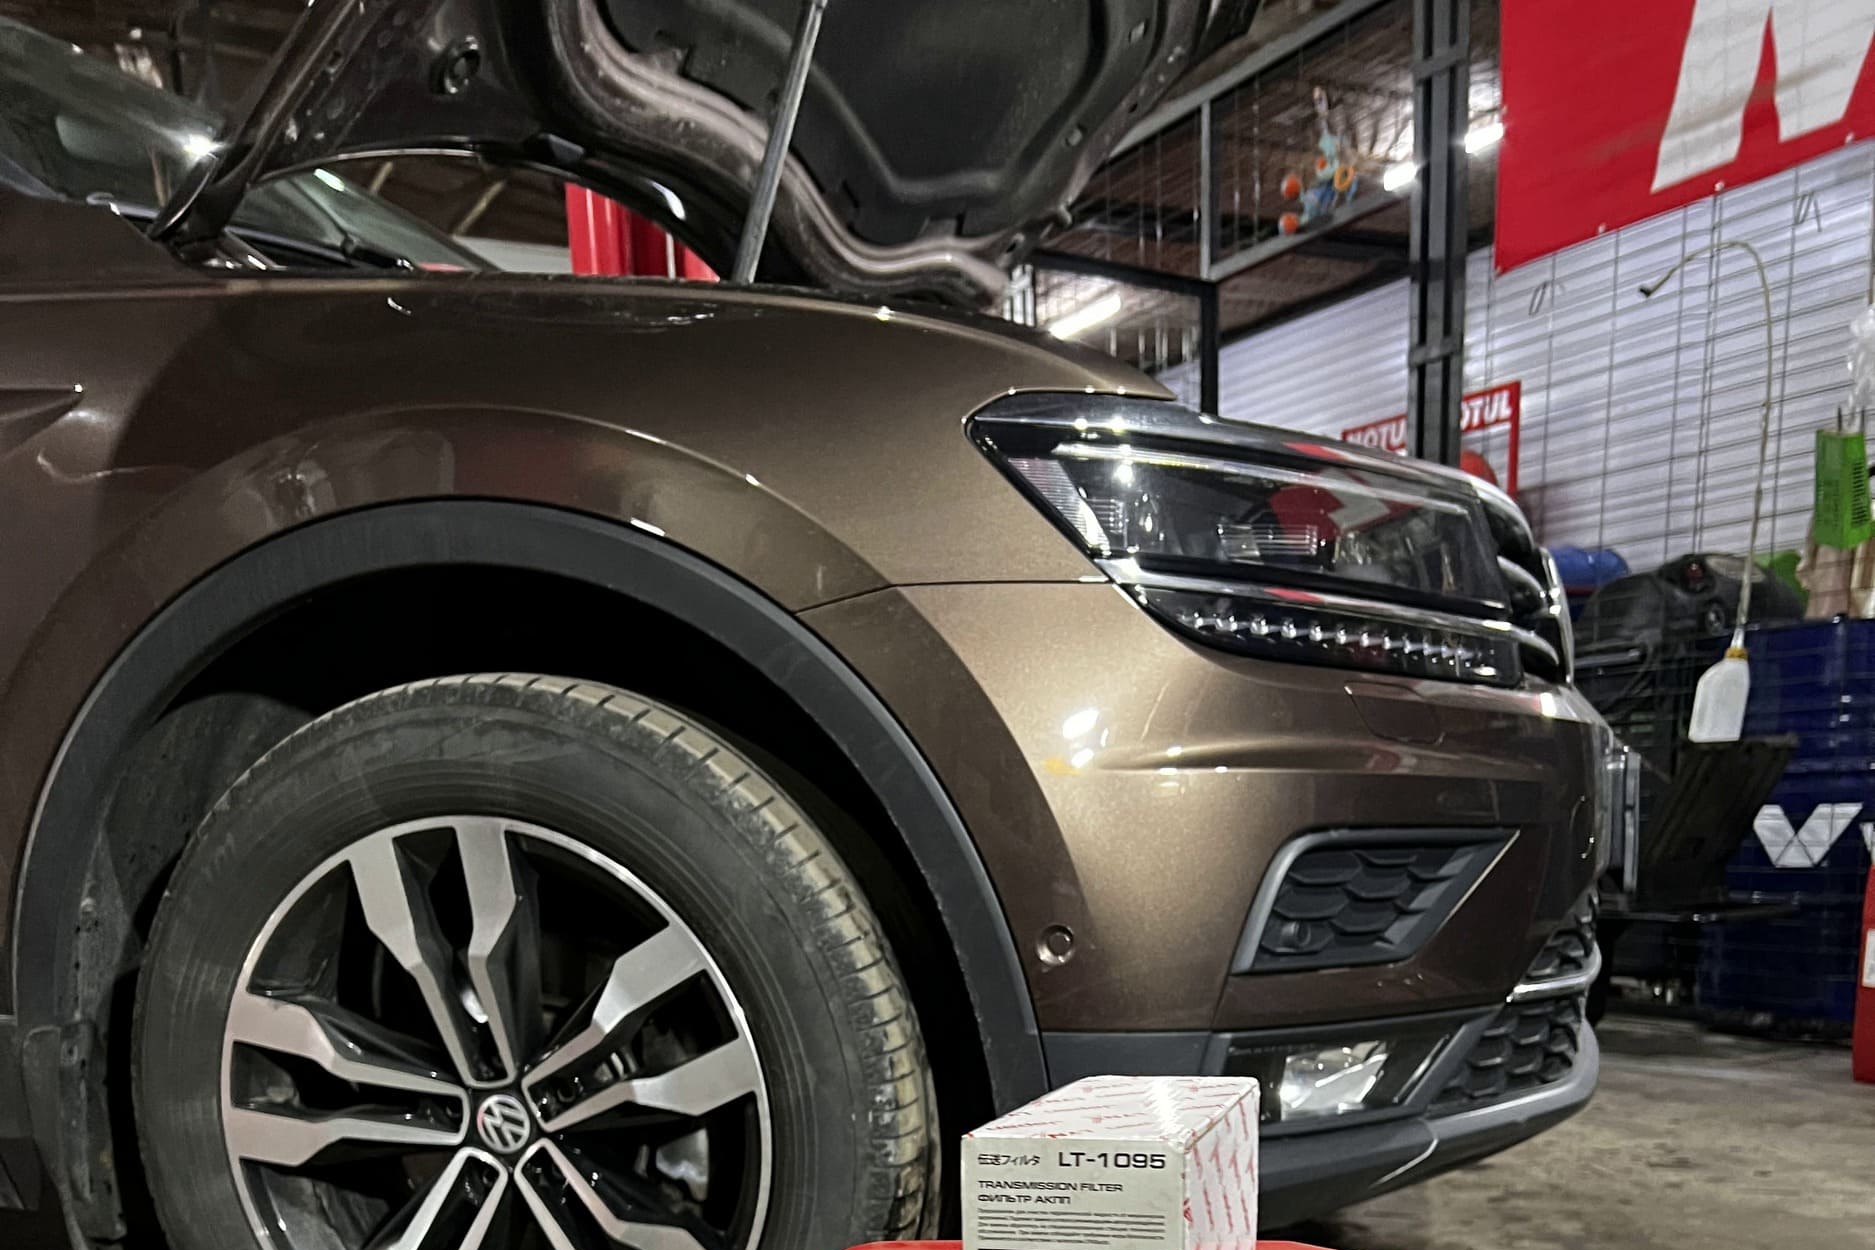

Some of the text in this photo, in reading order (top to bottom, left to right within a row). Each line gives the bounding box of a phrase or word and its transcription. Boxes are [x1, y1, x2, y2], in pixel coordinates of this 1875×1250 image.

[1346, 419, 1406, 450] MOTU
[1058, 1152, 1166, 1169] LT-1095
[977, 1180, 1123, 1192] TRANSMISSION FILTER
[977, 1194, 1071, 1204] ФИЛЬТР АКПП
